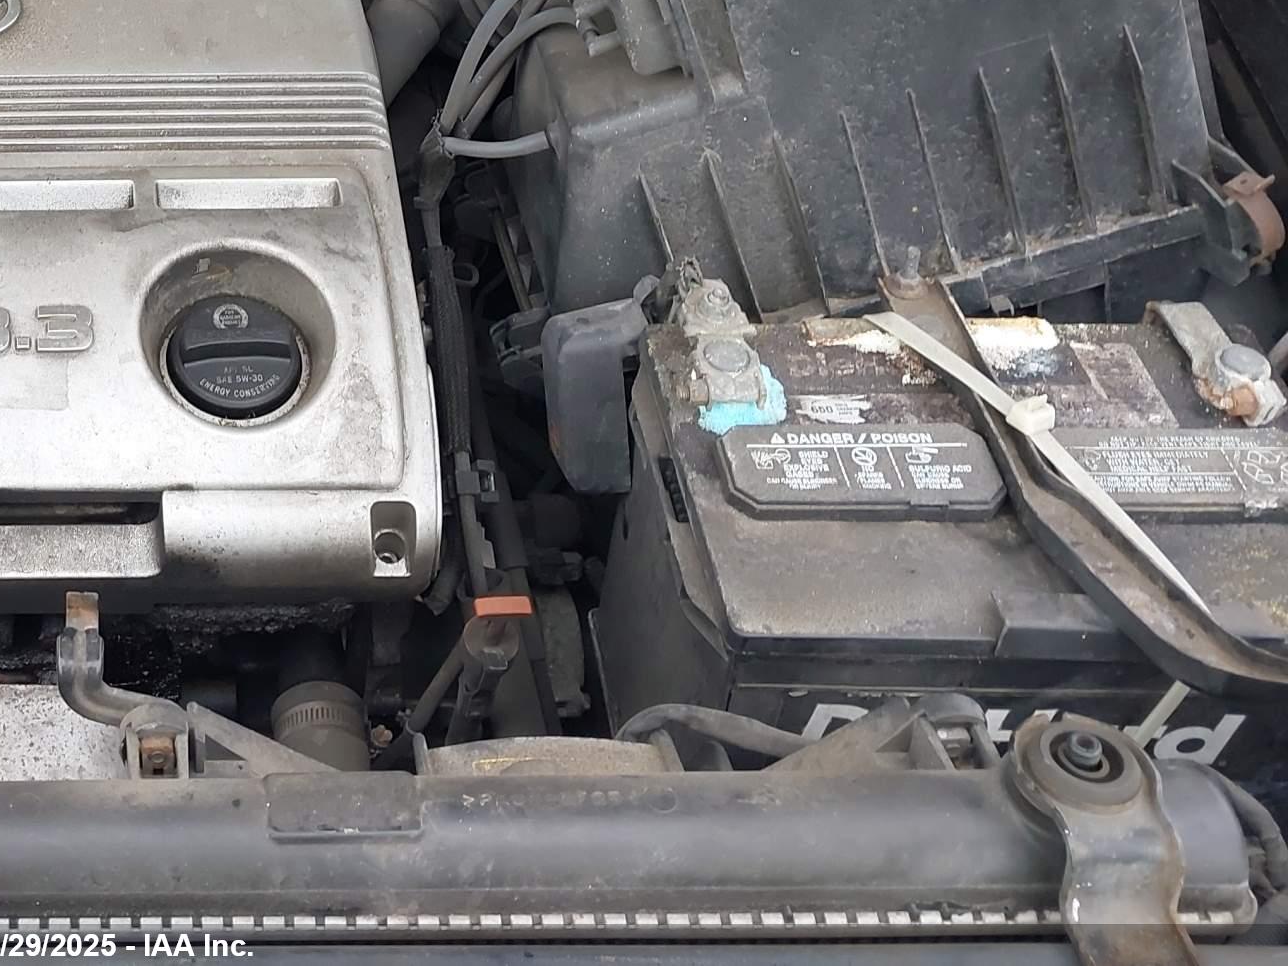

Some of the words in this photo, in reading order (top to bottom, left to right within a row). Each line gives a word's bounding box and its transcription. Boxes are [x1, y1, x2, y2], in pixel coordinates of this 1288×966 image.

[216, 375, 232, 384] SAE
[235, 374, 263, 383] 5W-30
[199, 377, 231, 397] ENERGY
[233, 373, 280, 398] CONSERVING
[810, 405, 834, 414] 650
[787, 432, 854, 445] DANGER
[870, 432, 933, 444] POISON
[798, 450, 829, 458] SHIELD
[783, 464, 830, 472] EXPLOSIVE
[952, 465, 972, 473] ACID
